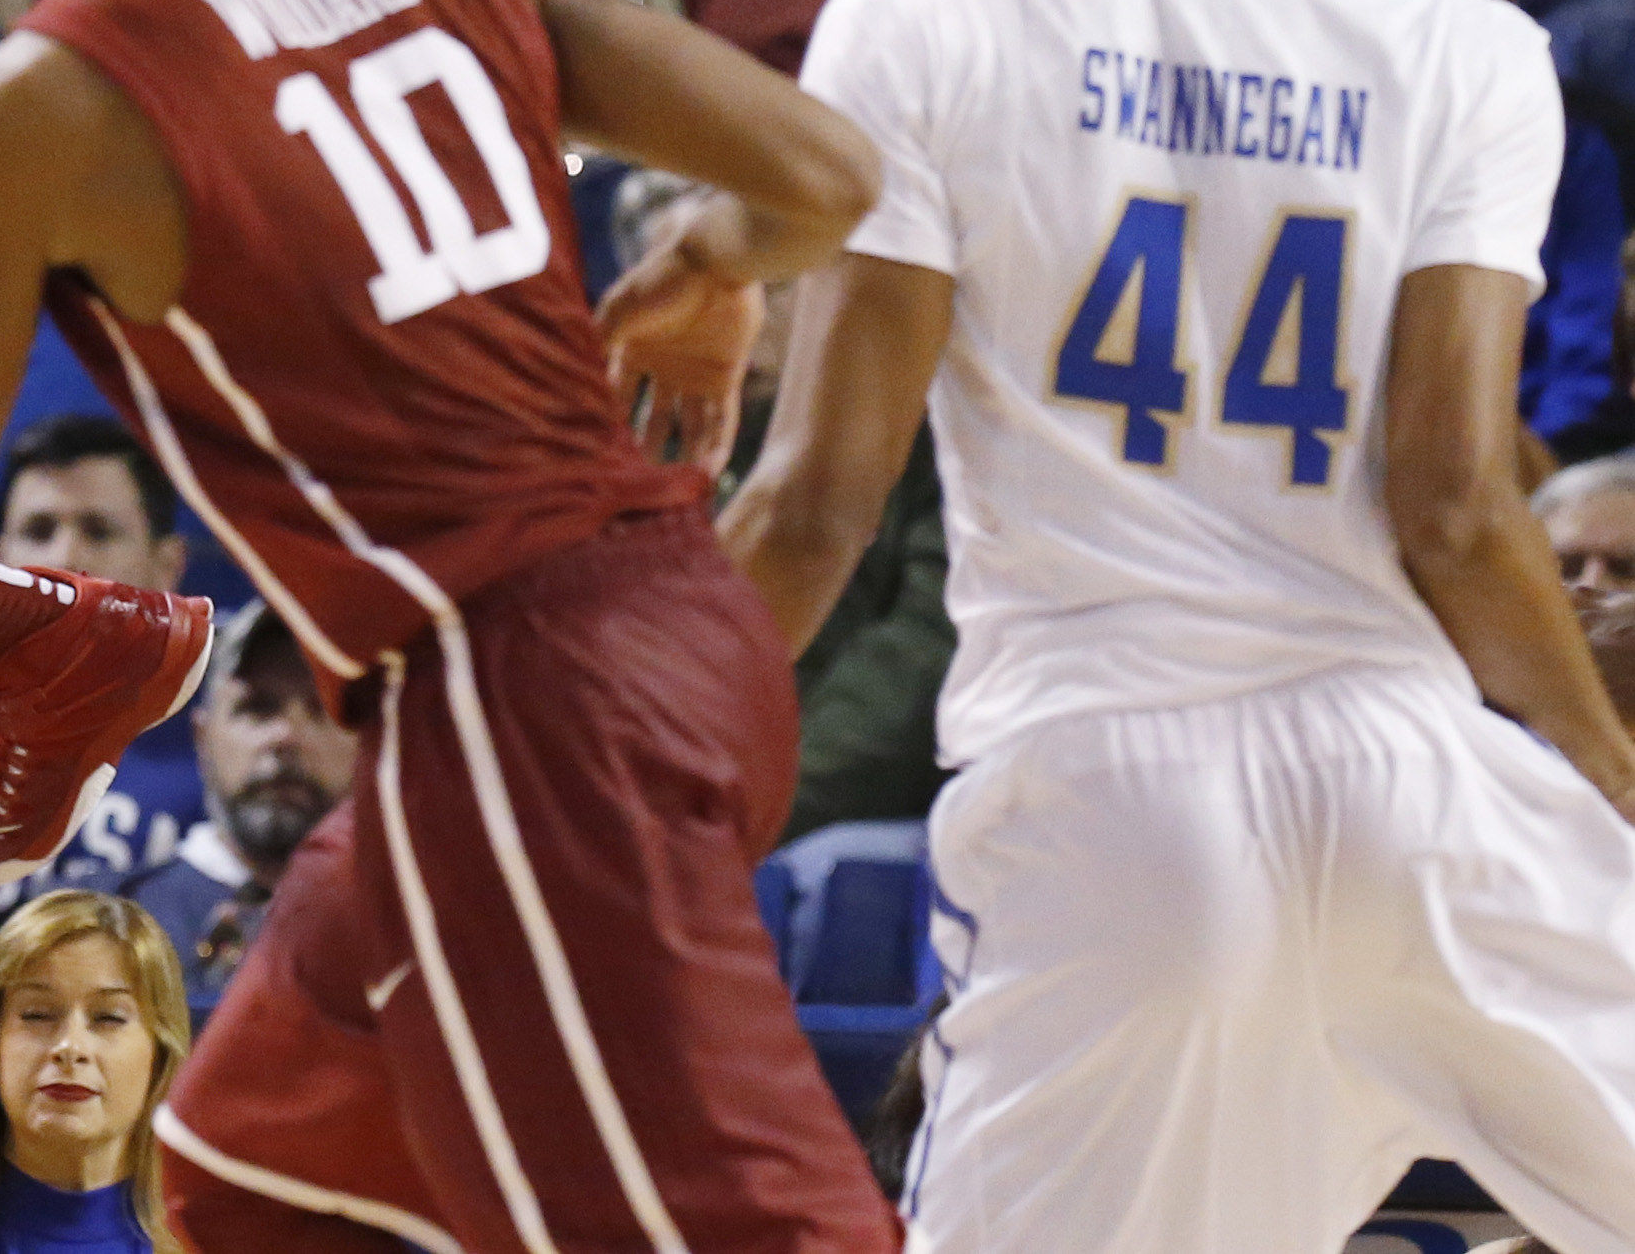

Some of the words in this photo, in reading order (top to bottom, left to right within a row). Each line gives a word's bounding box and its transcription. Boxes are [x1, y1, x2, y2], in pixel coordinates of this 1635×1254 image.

[273, 25, 551, 326] 10
[1079, 48, 1370, 171] SWANNEGAN
[1042, 183, 1360, 495] 44
